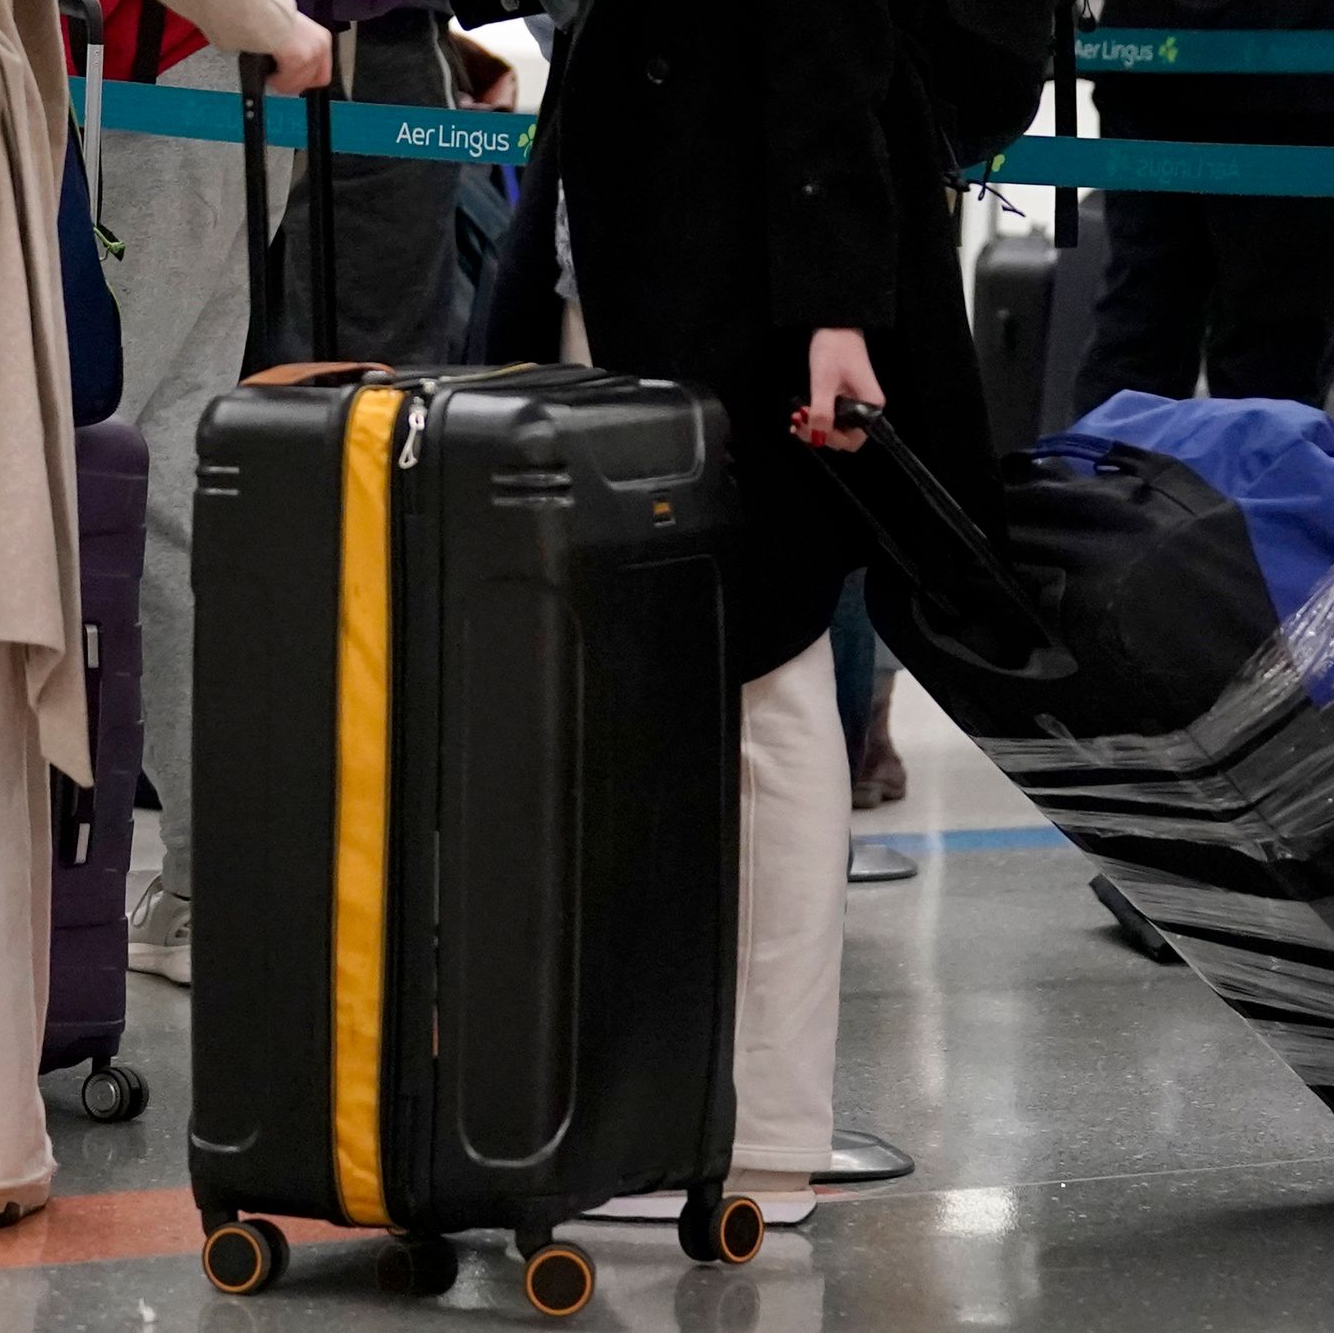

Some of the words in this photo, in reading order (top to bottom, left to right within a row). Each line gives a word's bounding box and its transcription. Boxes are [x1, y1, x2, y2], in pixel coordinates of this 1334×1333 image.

[1102, 40, 1153, 68] Lingus
[396, 122, 435, 146] Aer
[438, 124, 510, 157] Lingus
